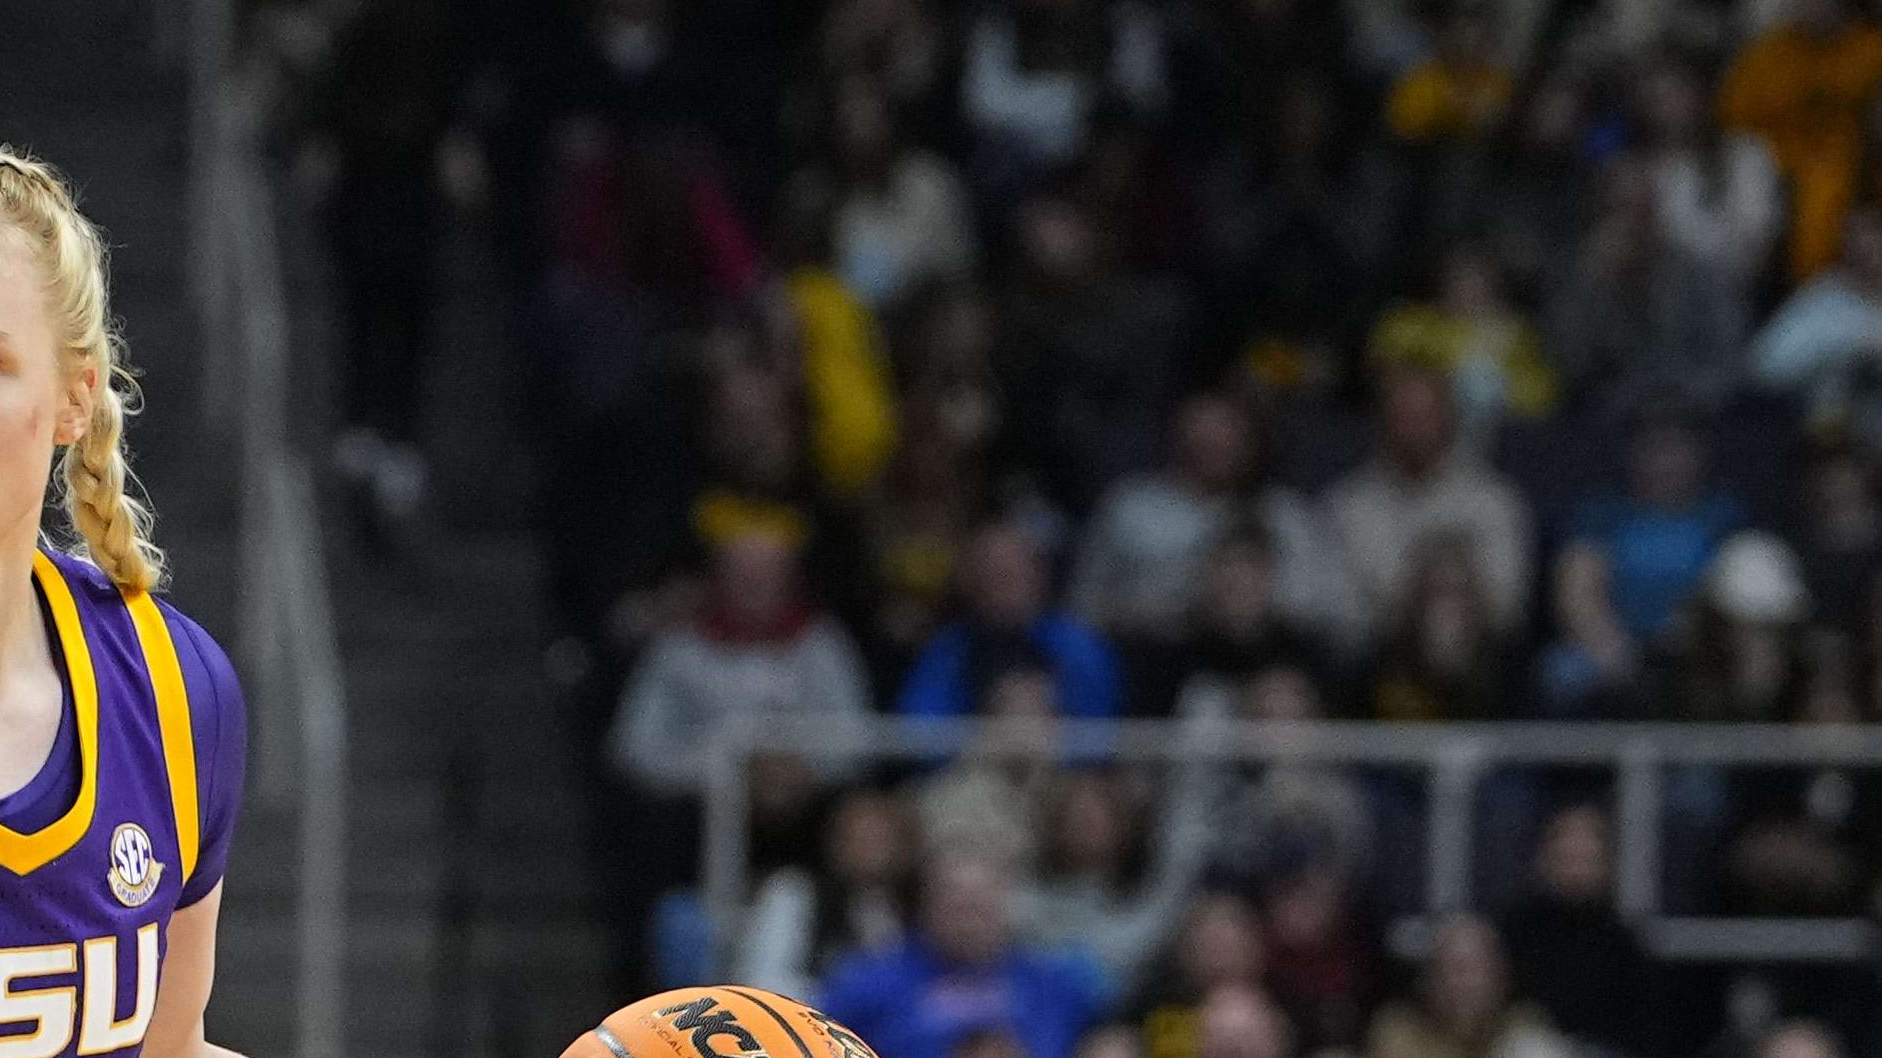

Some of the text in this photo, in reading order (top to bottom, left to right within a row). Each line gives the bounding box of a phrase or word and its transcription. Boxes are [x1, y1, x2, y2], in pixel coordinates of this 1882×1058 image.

[114, 828, 150, 886] SEC
[116, 878, 156, 904] GRADUATE
[638, 1016, 683, 1057] FICIAL
